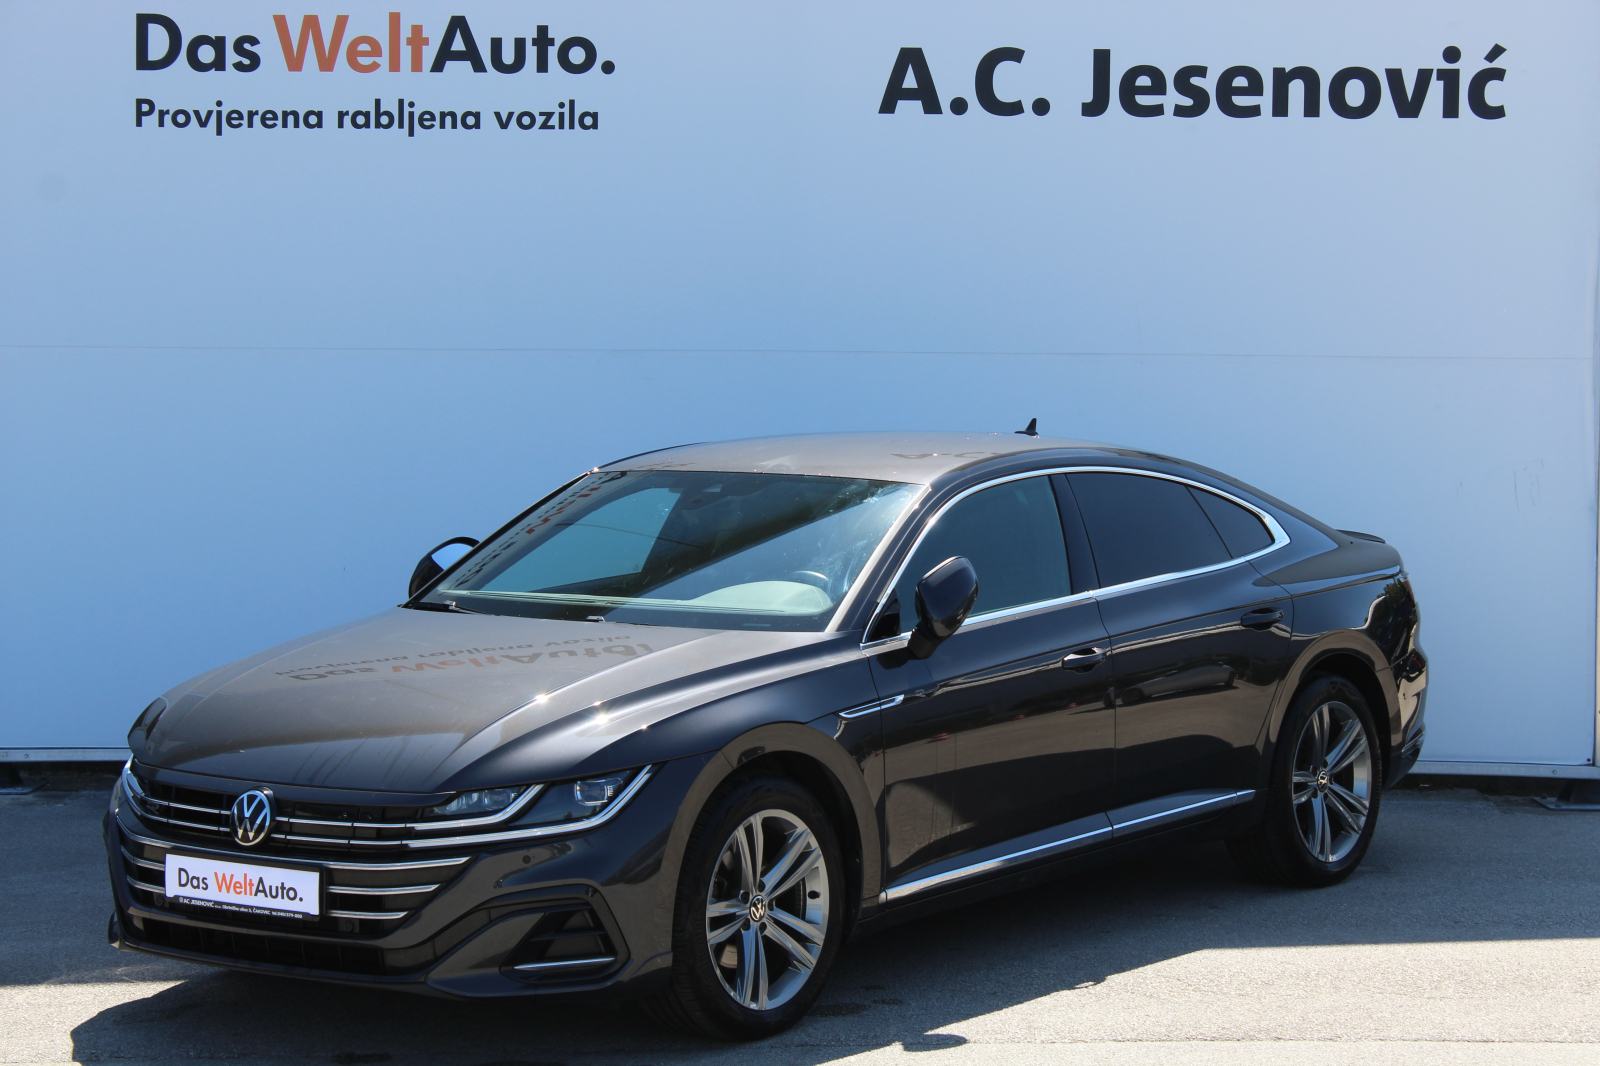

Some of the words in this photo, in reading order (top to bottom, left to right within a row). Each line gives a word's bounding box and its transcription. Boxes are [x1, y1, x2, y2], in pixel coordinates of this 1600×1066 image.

[135, 12, 261, 73] Das
[272, 11, 616, 75] WeltAuto.
[877, 46, 1051, 117] A.C.
[1081, 43, 1508, 120] Jesenović
[135, 98, 324, 137] Provjerena
[337, 98, 481, 138] rabljena
[493, 98, 599, 131] vozila
[178, 867, 209, 891] Das
[213, 871, 304, 903] WeltAuto.
